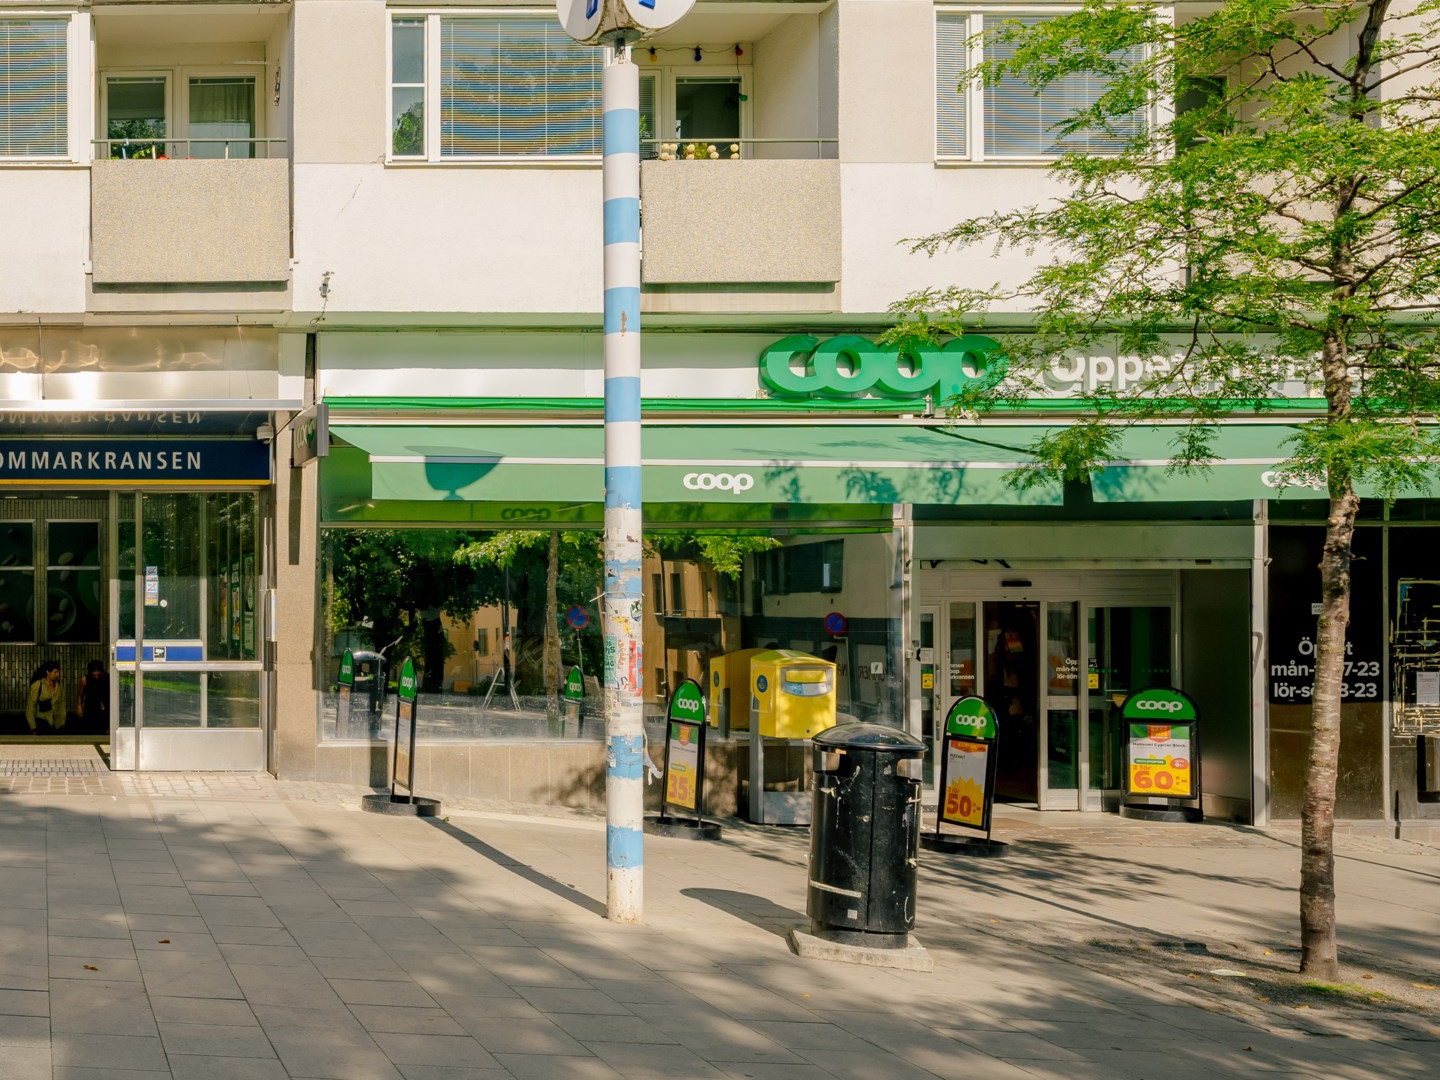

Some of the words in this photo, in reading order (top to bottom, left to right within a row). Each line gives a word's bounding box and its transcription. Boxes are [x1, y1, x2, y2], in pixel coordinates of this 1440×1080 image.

[759, 335, 1009, 406] coop
[683, 472, 754, 494] coop
[677, 698, 700, 713] coop
[1136, 700, 1183, 713] coop
[955, 714, 987, 730] coop
